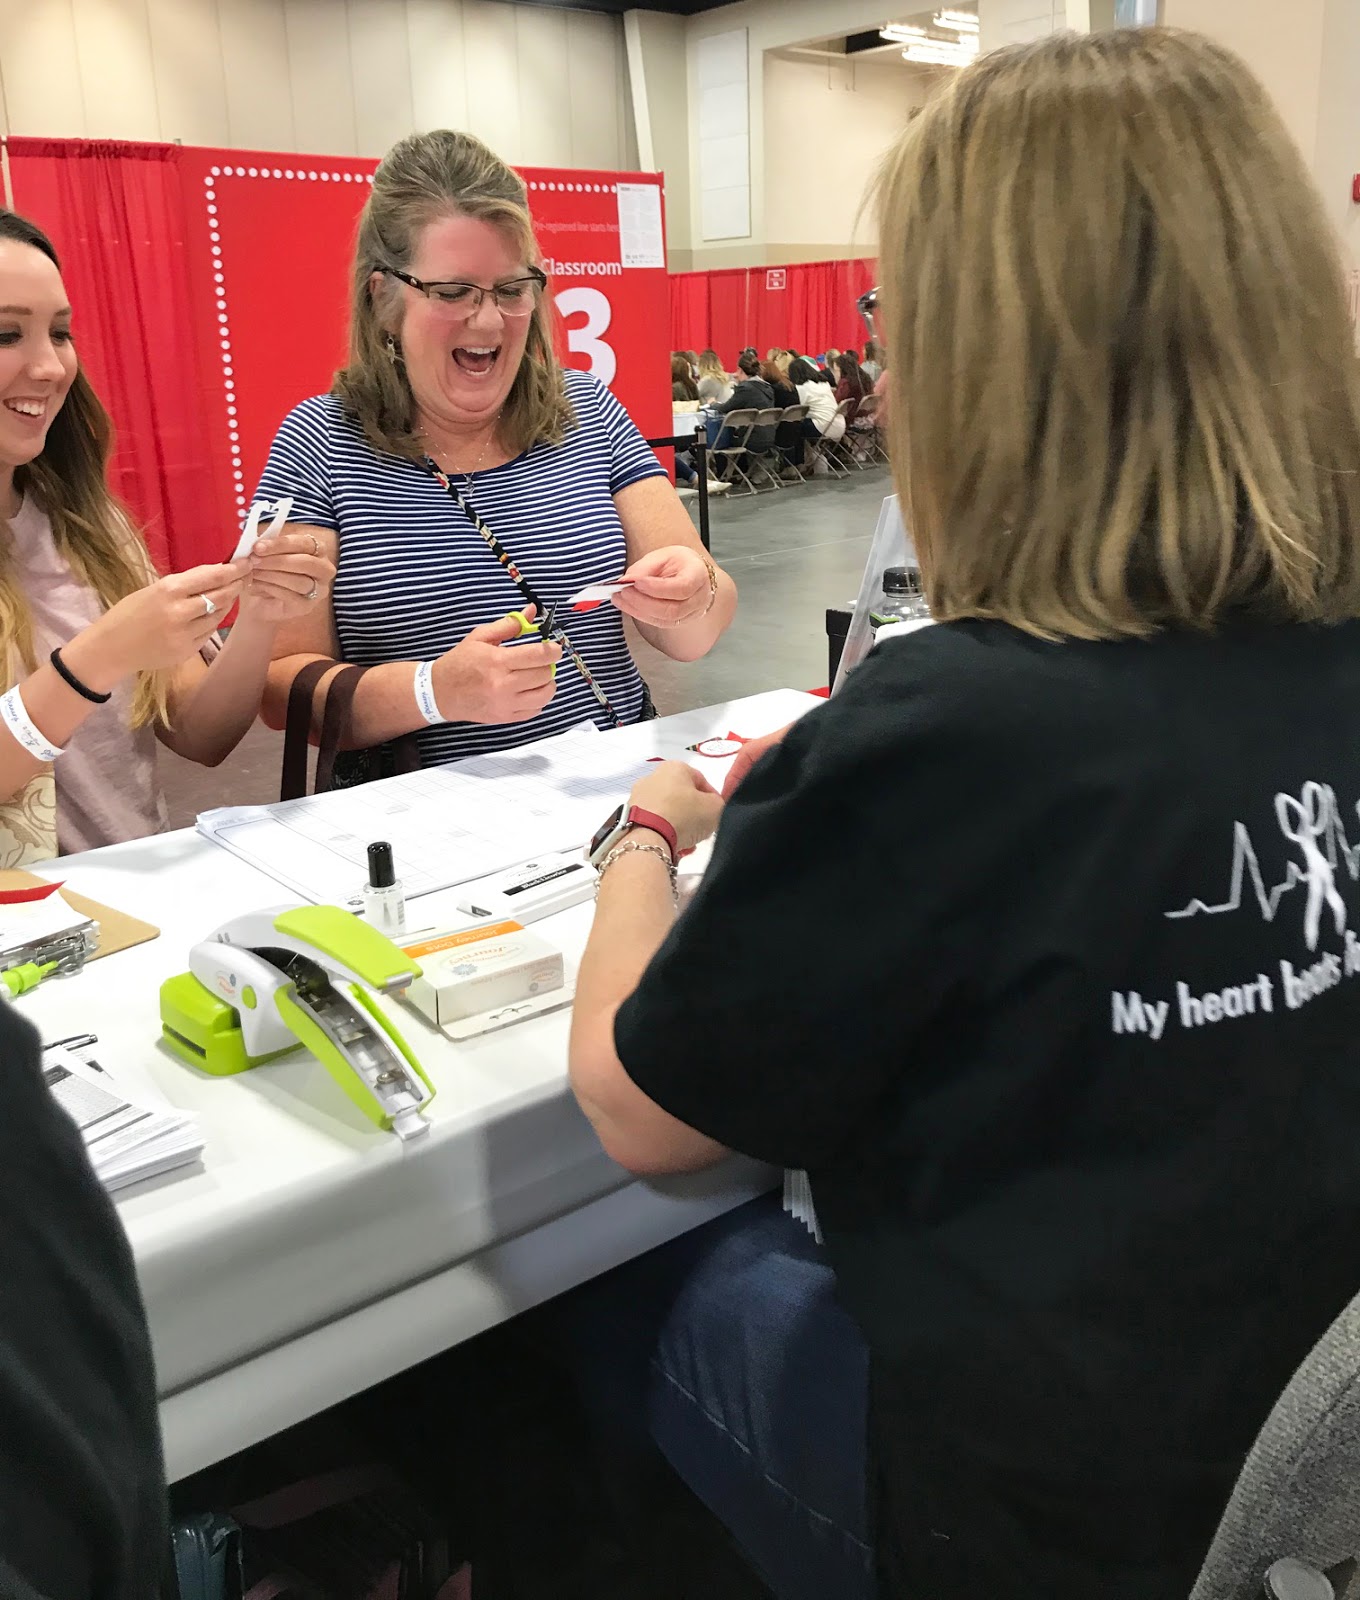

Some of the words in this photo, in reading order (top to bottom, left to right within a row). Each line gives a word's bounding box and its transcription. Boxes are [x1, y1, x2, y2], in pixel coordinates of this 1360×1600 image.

[554, 287, 617, 388] 3
[1110, 989, 1170, 1040] My
[1176, 972, 1274, 1028] heart
